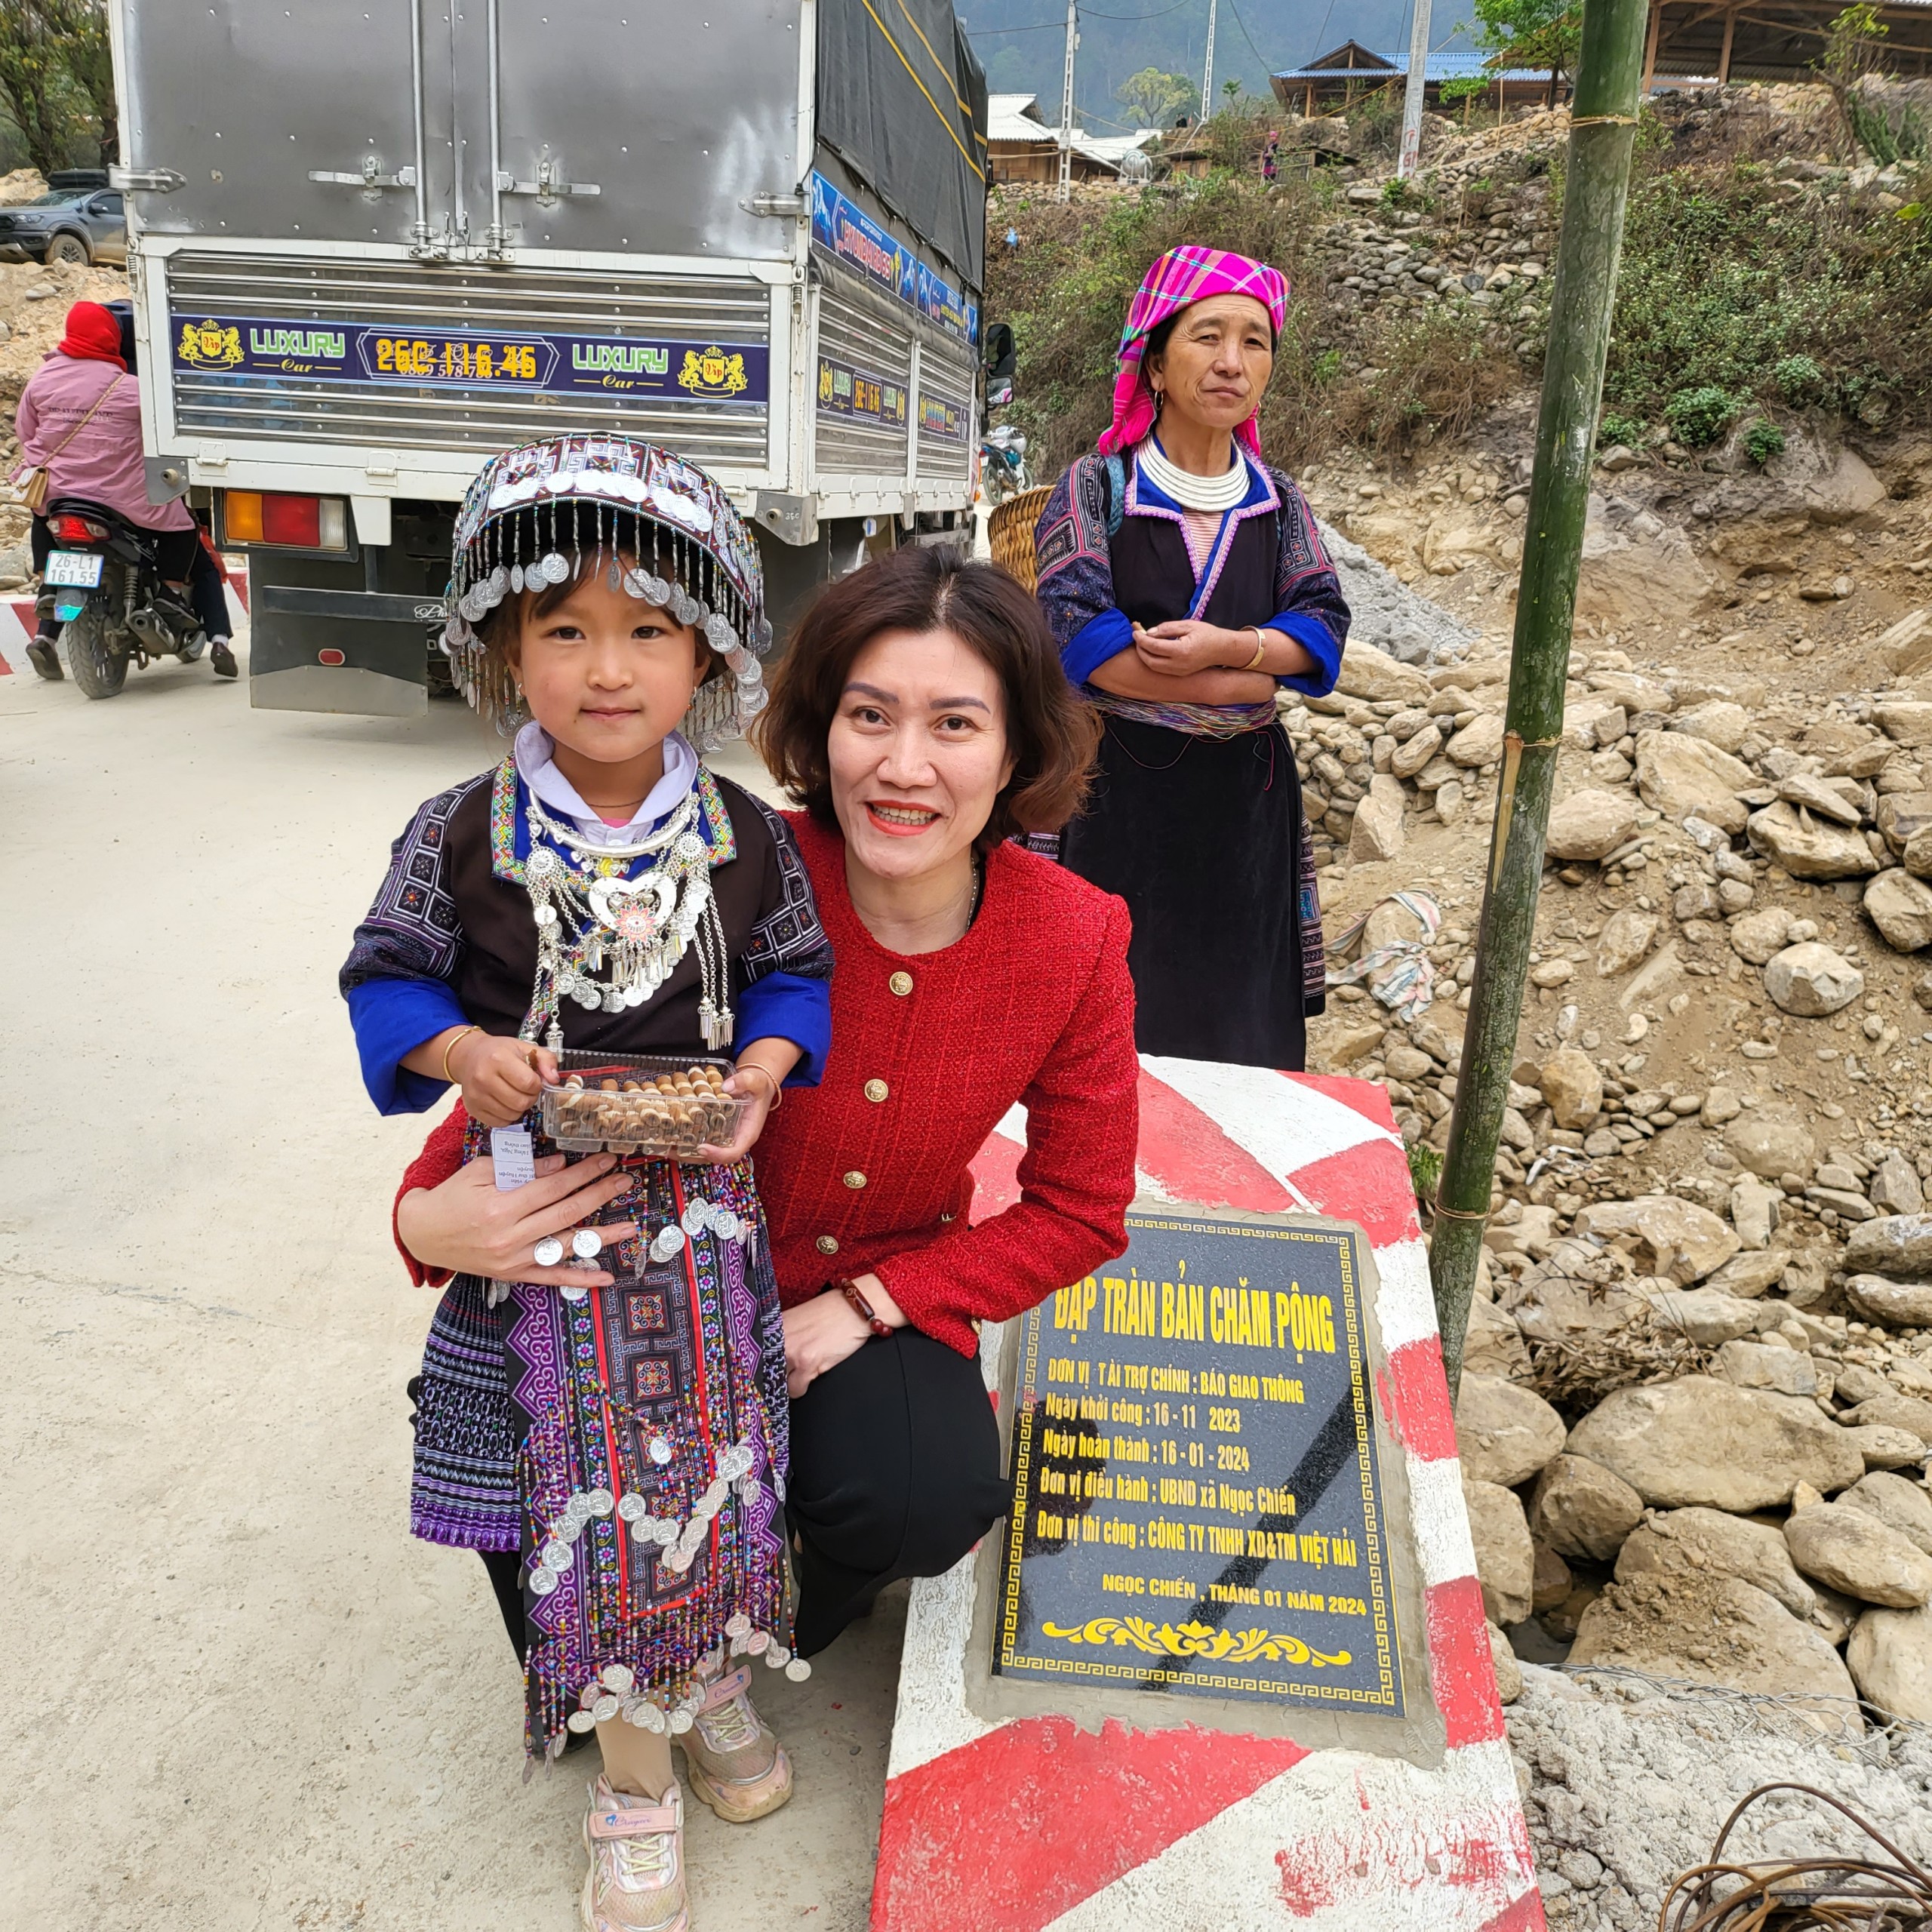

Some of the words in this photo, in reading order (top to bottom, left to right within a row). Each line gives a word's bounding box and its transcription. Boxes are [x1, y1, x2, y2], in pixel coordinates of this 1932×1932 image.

[204, 335, 220, 352] Vip
[250, 328, 346, 358] LUXURY
[572, 343, 669, 374] LUXURY
[281, 358, 313, 374] Car
[602, 374, 635, 389] Car
[705, 361, 722, 379] Vip
[51, 569, 97, 585] 161.55
[55, 554, 94, 570] 26-L1
[1103, 1267, 1155, 1337] TRÀN
[1161, 1259, 1204, 1341] BẢN
[1210, 1276, 1272, 1347] CHĂM
[1275, 1281, 1336, 1364] PỘNG
[1048, 1358, 1075, 1383] ĐƠN
[1078, 1360, 1090, 1389] VỊ
[1124, 1364, 1149, 1395] TRỢ
[1151, 1363, 1189, 1394] CHÍNH
[1200, 1367, 1226, 1396] BÁO
[1229, 1374, 1259, 1400] GIAO
[1261, 1373, 1304, 1404] THÔNG
[1045, 1392, 1078, 1422] Ngày
[1080, 1393, 1108, 1421] khởi
[1112, 1398, 1143, 1426] công
[1153, 1401, 1169, 1426] 16
[1181, 1404, 1196, 1429] 11
[1209, 1406, 1240, 1433] 2023
[1043, 1428, 1076, 1460] Ngày
[1078, 1431, 1110, 1460] hoàn
[1114, 1435, 1149, 1463] thành
[1161, 1439, 1177, 1466] 16
[1189, 1441, 1204, 1468] 01
[1217, 1444, 1250, 1472] 2024
[1040, 1466, 1066, 1495] Đơn
[1069, 1469, 1081, 1503] vị
[1084, 1467, 1113, 1500] điều
[1116, 1473, 1149, 1503] hành
[1160, 1478, 1196, 1507] UBND
[1200, 1478, 1217, 1509] xã
[1220, 1483, 1254, 1517] Ngọc
[1257, 1484, 1296, 1516] Chiến
[1037, 1510, 1063, 1540] Đơn
[1066, 1513, 1079, 1547] vị
[1081, 1515, 1100, 1543] thi
[1103, 1516, 1137, 1550] công
[1148, 1515, 1186, 1551] CÔNG
[1188, 1524, 1204, 1552] TY
[1208, 1526, 1244, 1556] TNHH
[1247, 1529, 1297, 1561] XD&TM
[1299, 1530, 1328, 1570] VIỆT
[1331, 1527, 1357, 1567] HẢI
[1103, 1574, 1145, 1597] NGỌC
[1149, 1575, 1196, 1599] CHIẾN
[1208, 1582, 1260, 1606] THÁNG
[1263, 1589, 1281, 1607] 01
[1287, 1589, 1325, 1612] NĂM
[1328, 1595, 1367, 1616] 2024
